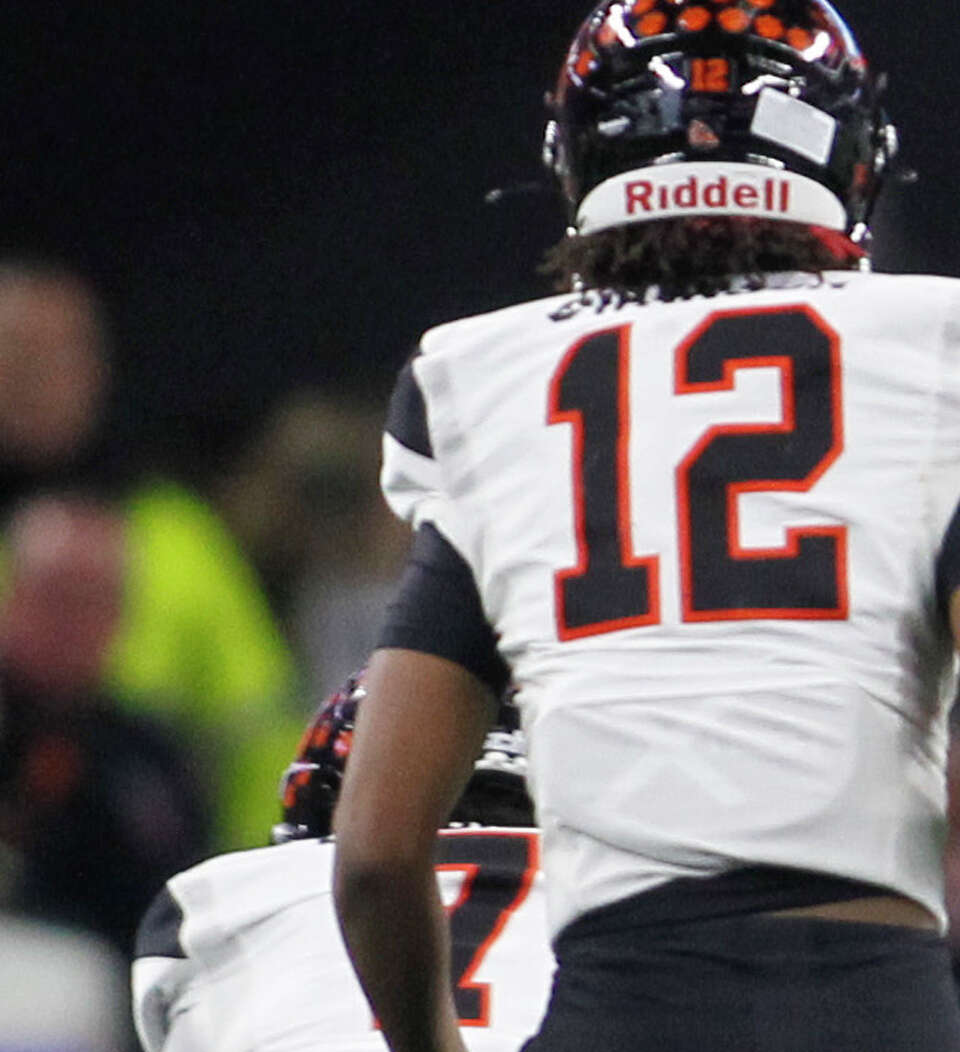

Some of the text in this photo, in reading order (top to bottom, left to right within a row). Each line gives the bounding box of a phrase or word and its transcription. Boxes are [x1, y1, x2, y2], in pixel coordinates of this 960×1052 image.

[691, 57, 729, 92] 12
[625, 176, 790, 215] Riddell
[546, 303, 848, 642] 12
